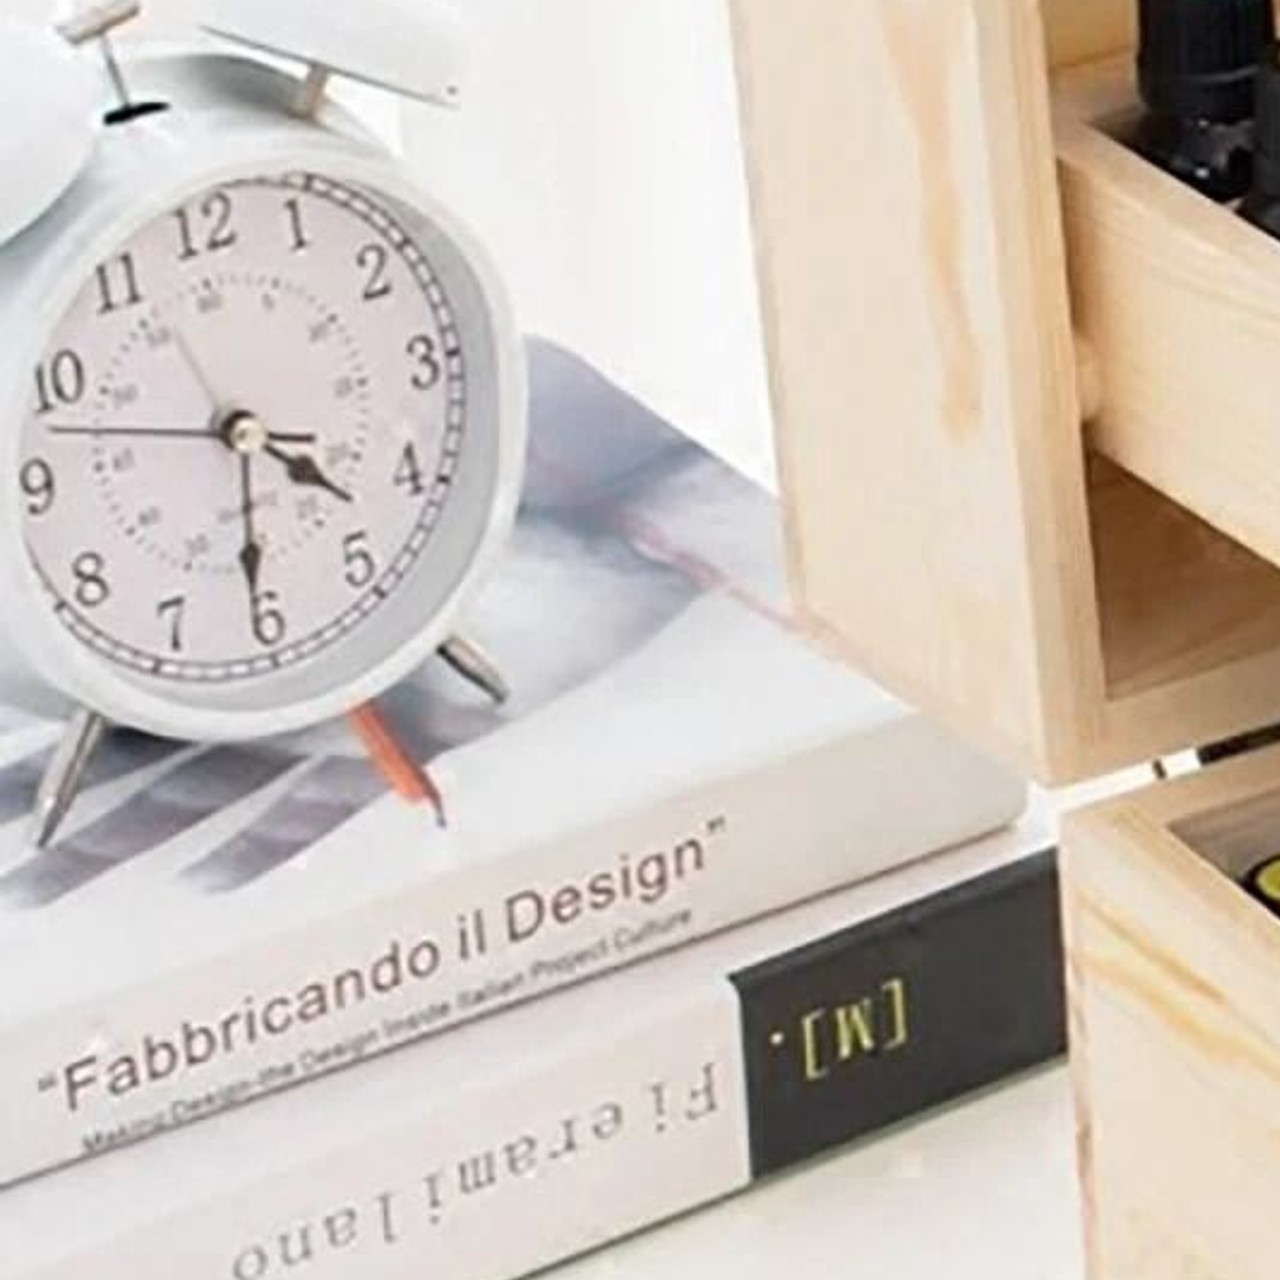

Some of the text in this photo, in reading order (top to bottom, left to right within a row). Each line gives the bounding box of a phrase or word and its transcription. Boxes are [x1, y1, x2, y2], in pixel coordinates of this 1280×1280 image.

[174, 192, 237, 261] 12
[284, 199, 309, 251] 1
[95, 253, 143, 314] 11
[356, 244, 393, 300] 2
[33, 350, 85, 413] 10
[406, 336, 441, 390] 3
[19, 457, 56, 515] 9
[393, 442, 426, 498] 4
[71, 552, 110, 607] 8
[342, 531, 375, 587] 5
[158, 596, 186, 651] 7
[251, 591, 286, 646] 6
[457, 908, 487, 960] il
